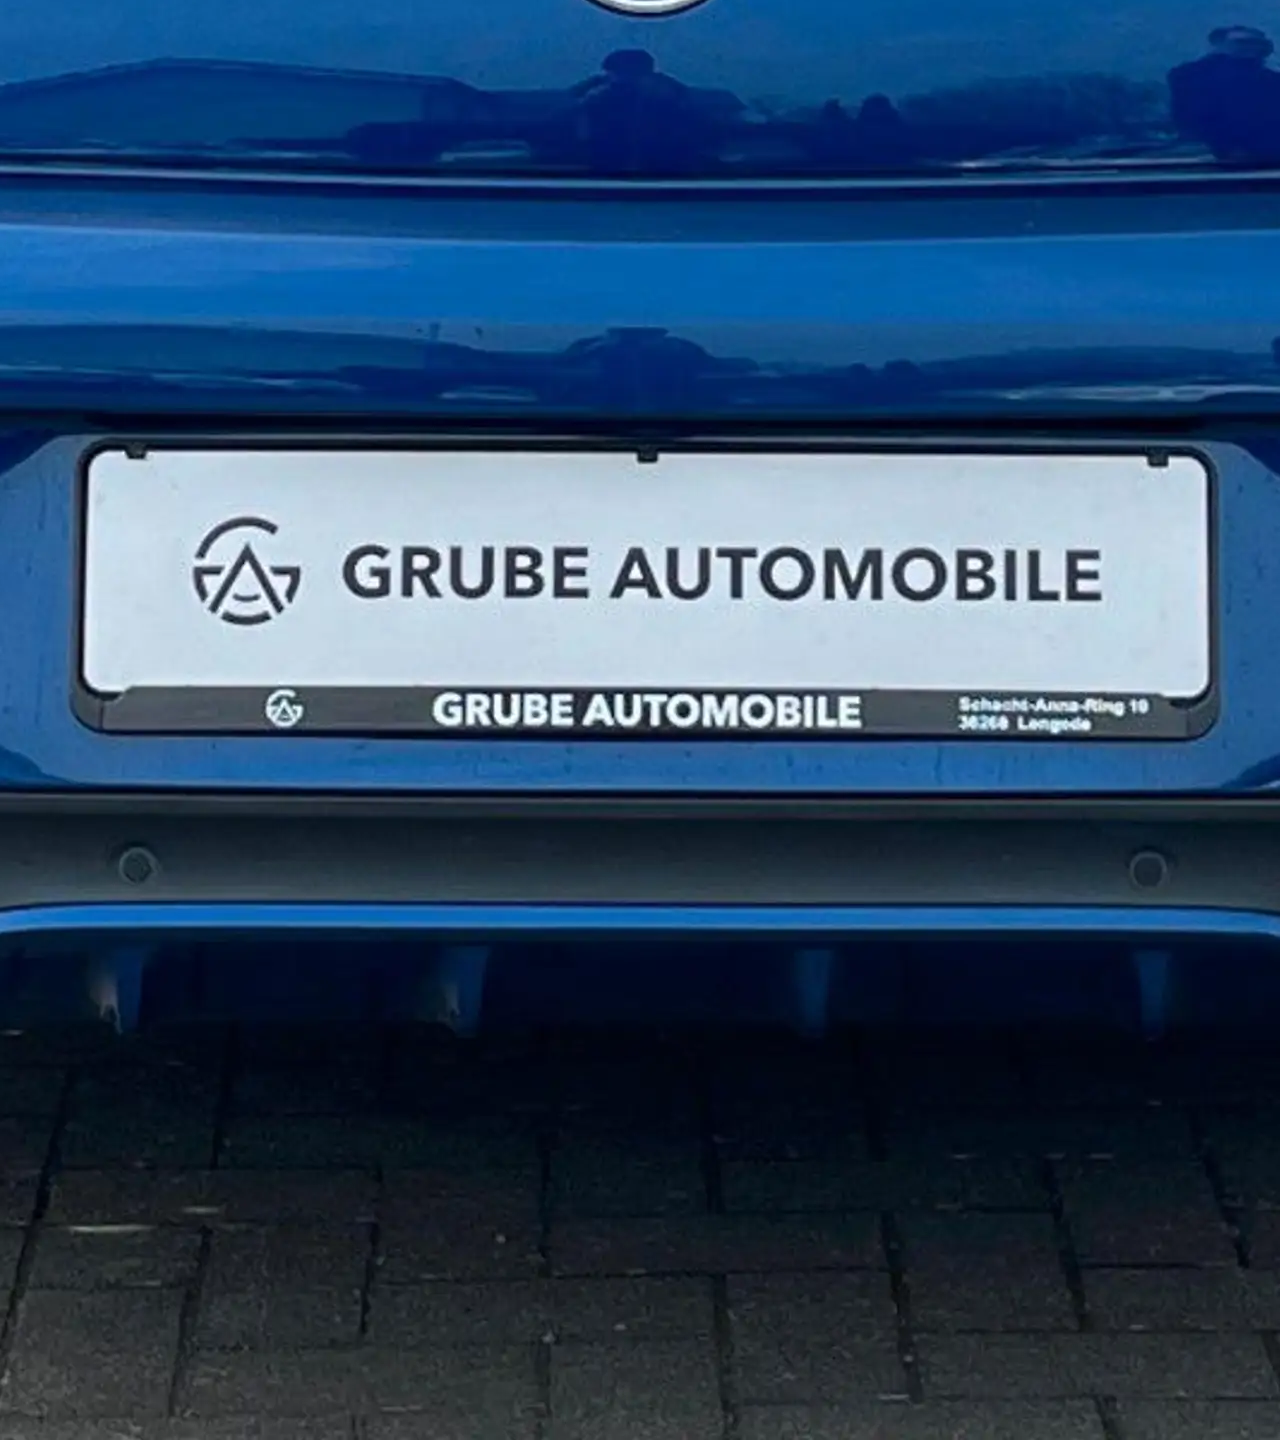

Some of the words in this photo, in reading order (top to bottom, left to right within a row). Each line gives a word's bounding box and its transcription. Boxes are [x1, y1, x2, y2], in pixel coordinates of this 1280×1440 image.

[342, 544, 590, 600] GRUBE
[609, 545, 1103, 603] AUTOMOBILE
[432, 691, 574, 728] GRUBE
[582, 693, 862, 729] AUTOMOBILE
